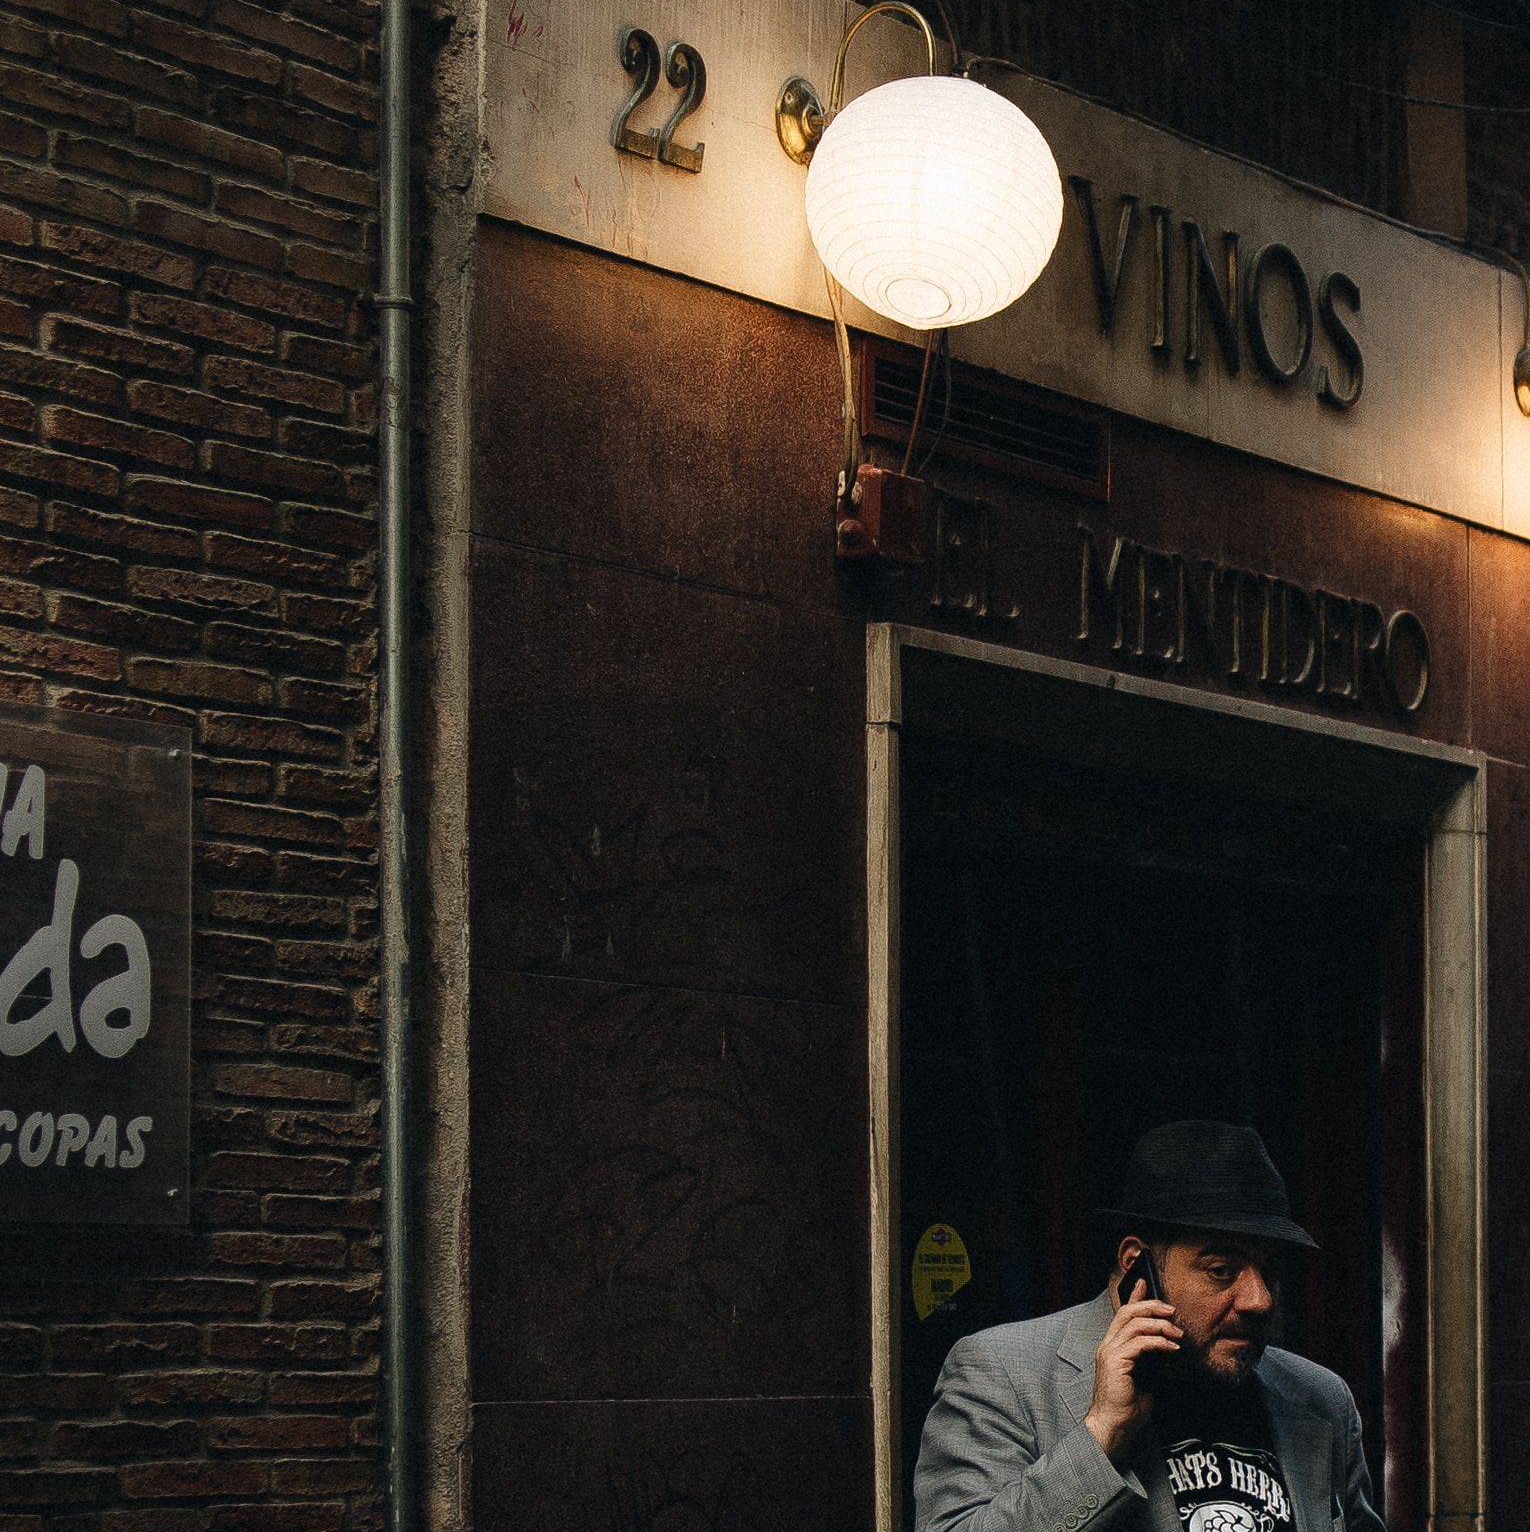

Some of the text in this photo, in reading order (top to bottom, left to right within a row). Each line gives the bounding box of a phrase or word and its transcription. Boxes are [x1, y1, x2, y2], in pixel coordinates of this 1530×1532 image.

[609, 27, 1365, 409] 22 VINOS
[1075, 519, 1431, 711] MENTIDERO
[0, 763, 46, 860] A
[1166, 1449, 1222, 1495] HATS
